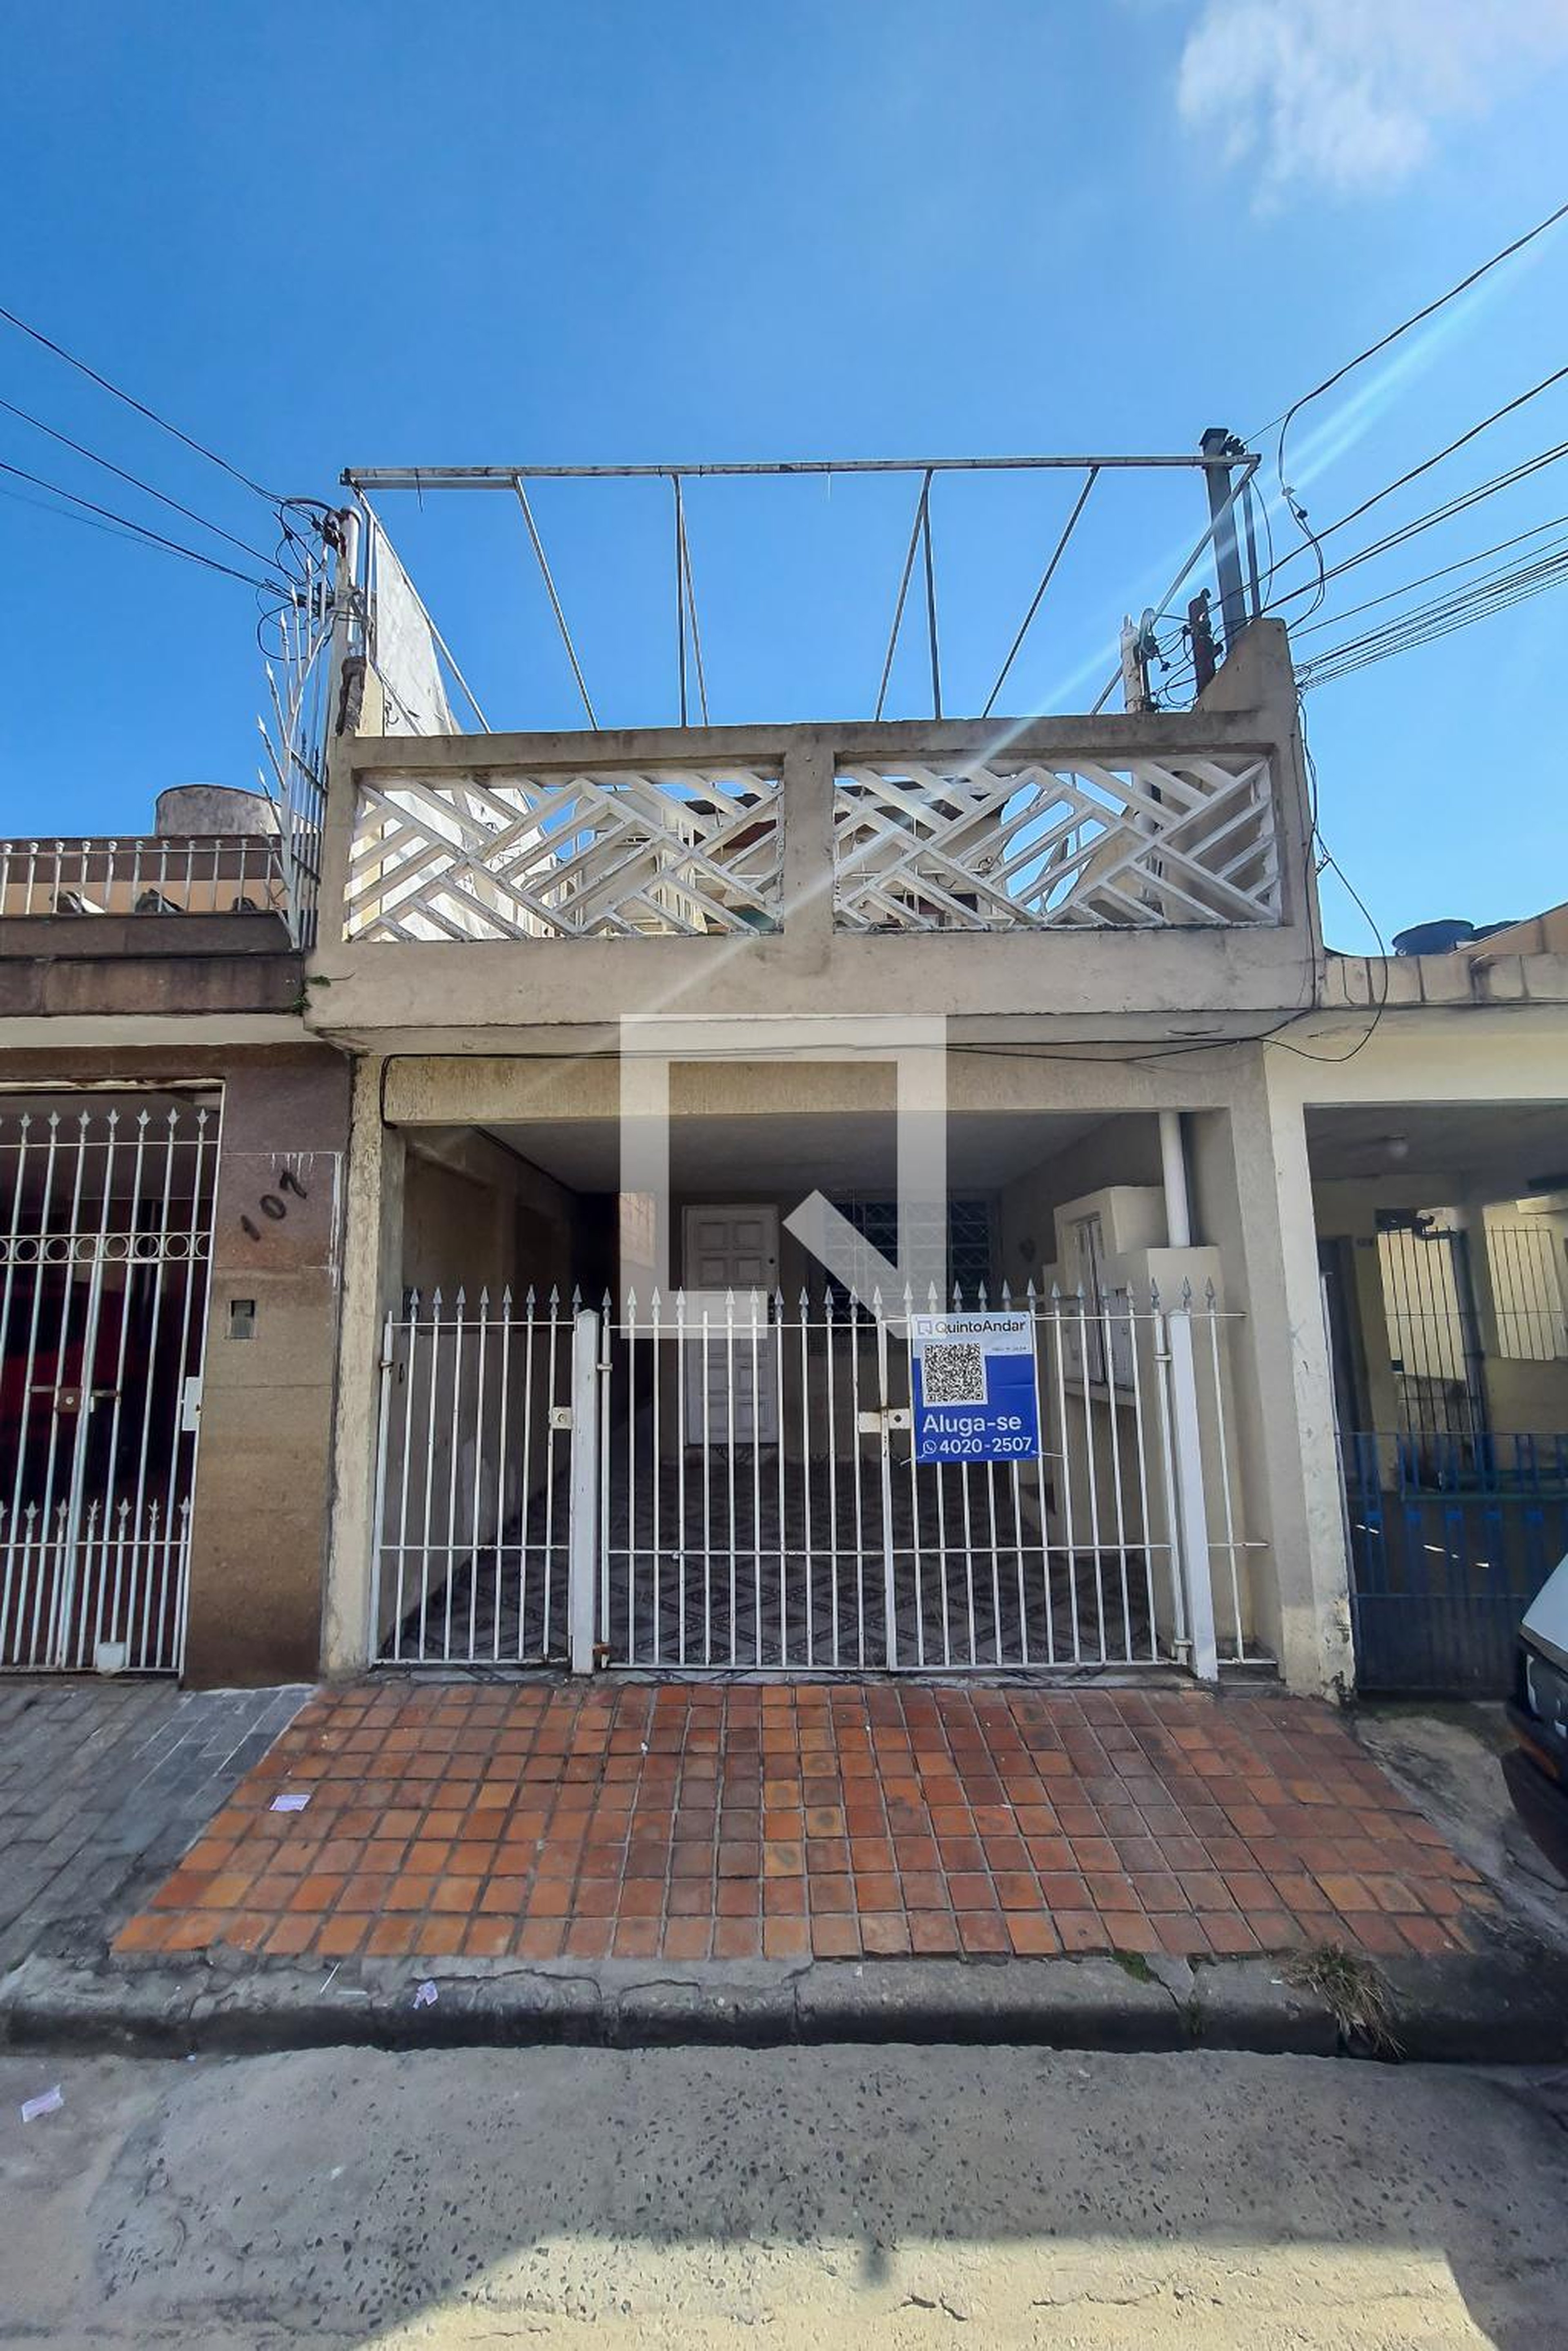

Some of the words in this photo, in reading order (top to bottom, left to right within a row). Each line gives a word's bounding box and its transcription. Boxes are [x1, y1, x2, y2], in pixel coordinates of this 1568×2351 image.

[241, 1170, 307, 1240] 107
[935, 1320, 1025, 1334] QuintoAndar
[923, 1414, 1022, 1436] Aluga-se
